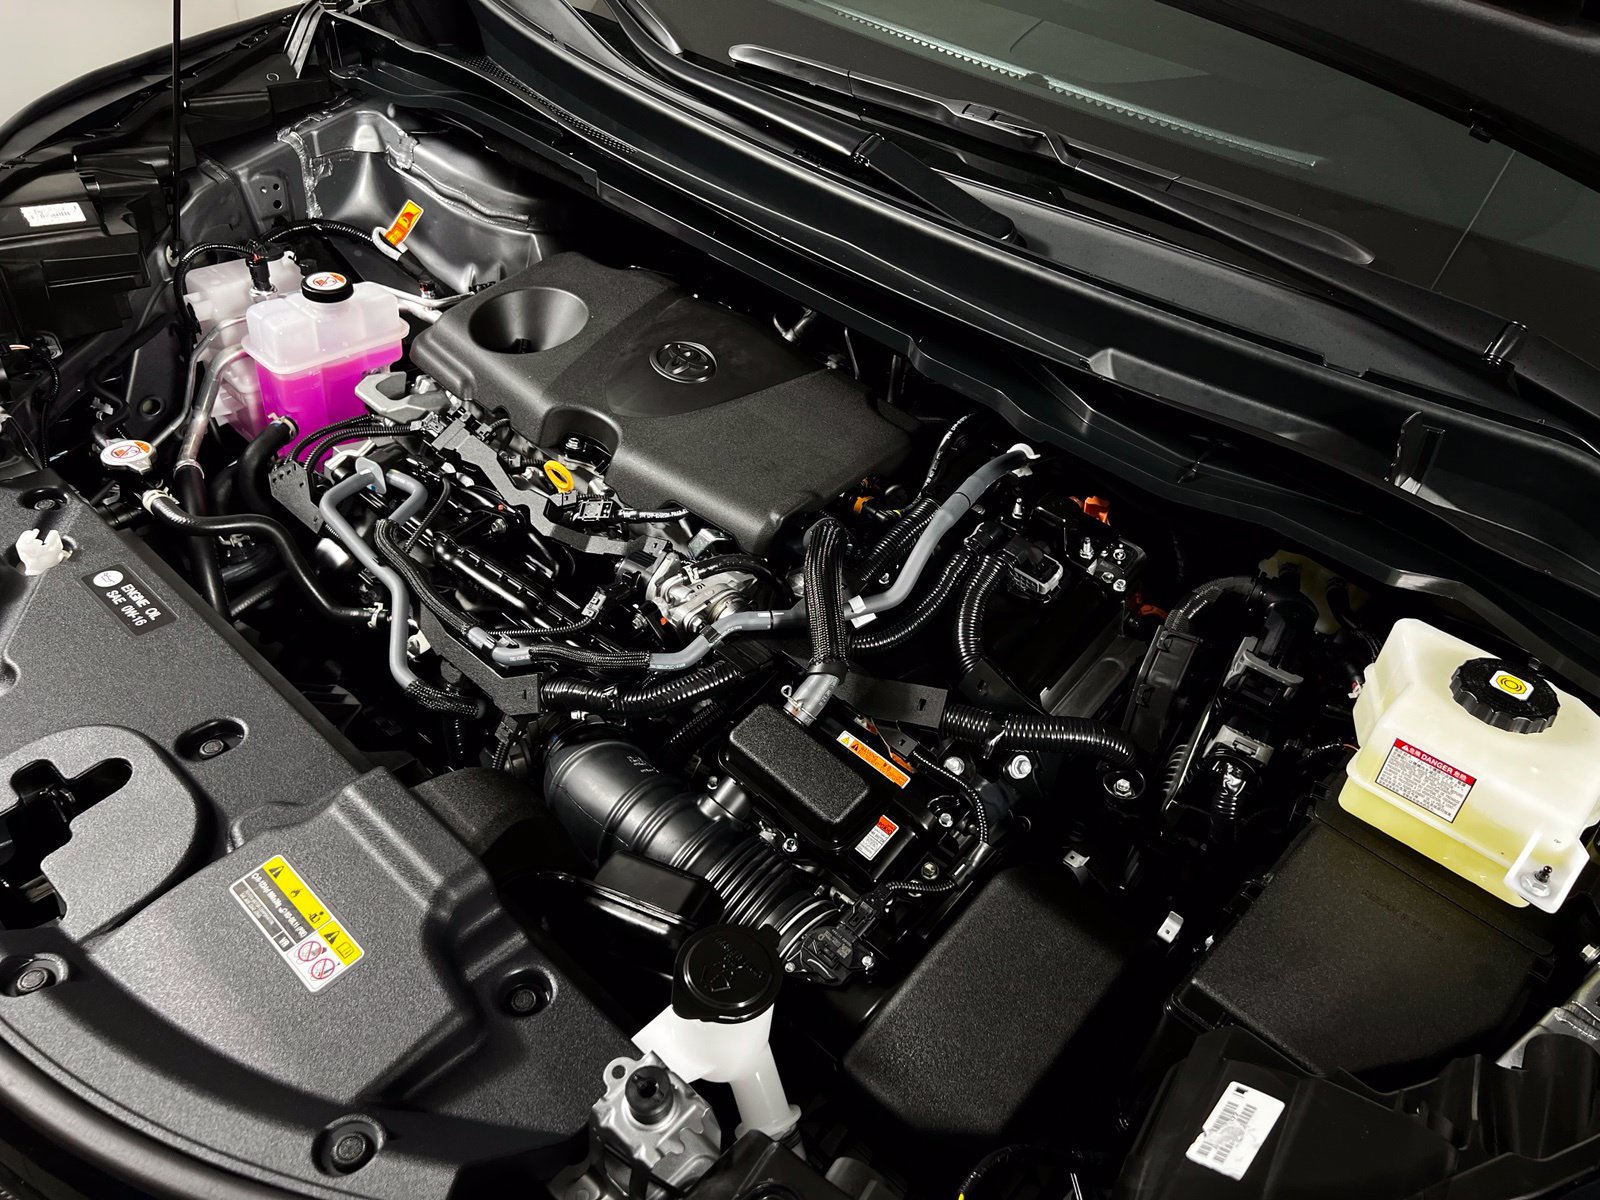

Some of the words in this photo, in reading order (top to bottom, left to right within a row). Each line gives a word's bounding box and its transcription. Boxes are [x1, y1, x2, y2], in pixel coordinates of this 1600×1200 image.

[106, 589, 127, 605] SAE
[120, 604, 148, 626] 0W-16
[120, 583, 151, 608] ENGINE
[144, 607, 162, 621] OIL
[1420, 753, 1453, 774] DANGER
